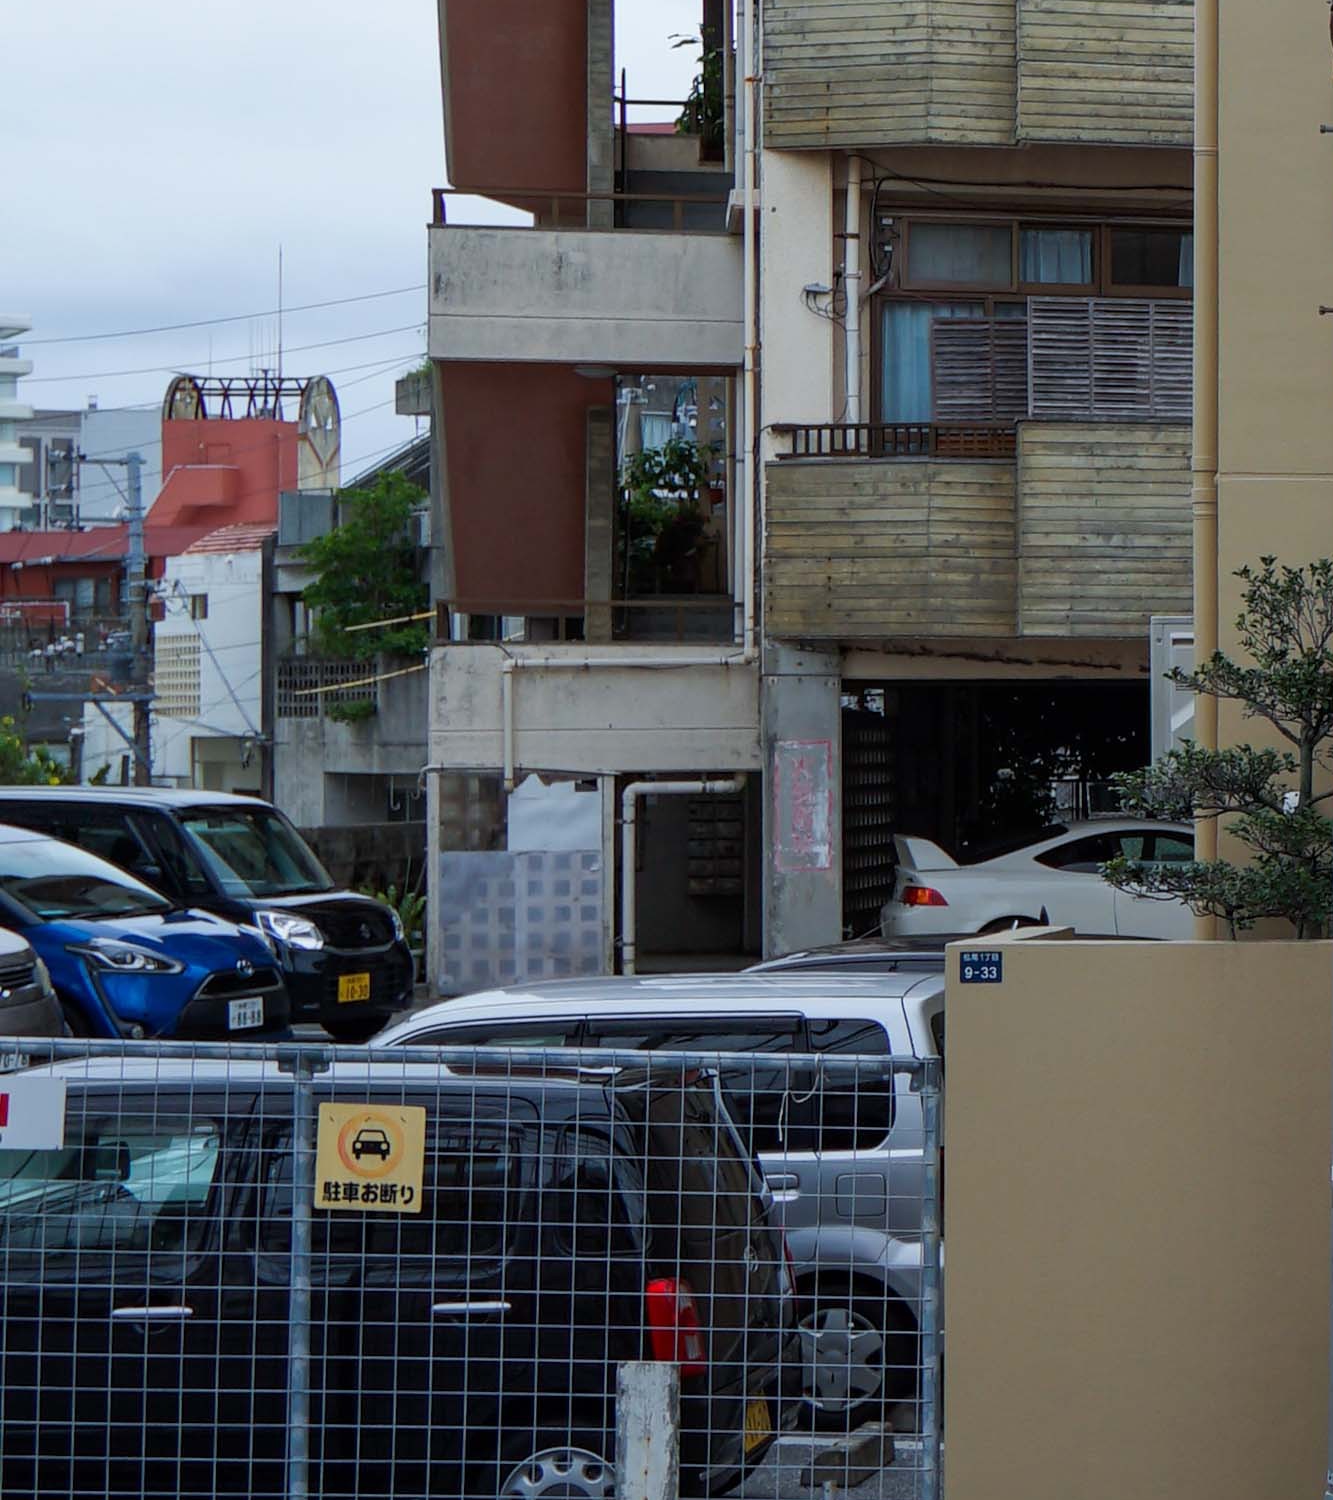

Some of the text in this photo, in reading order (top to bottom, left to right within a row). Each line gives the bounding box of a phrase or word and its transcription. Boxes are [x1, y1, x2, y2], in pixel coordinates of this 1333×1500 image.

[964, 966, 997, 979] 9-33
[322, 1181, 415, 1205] 駐車お断り
